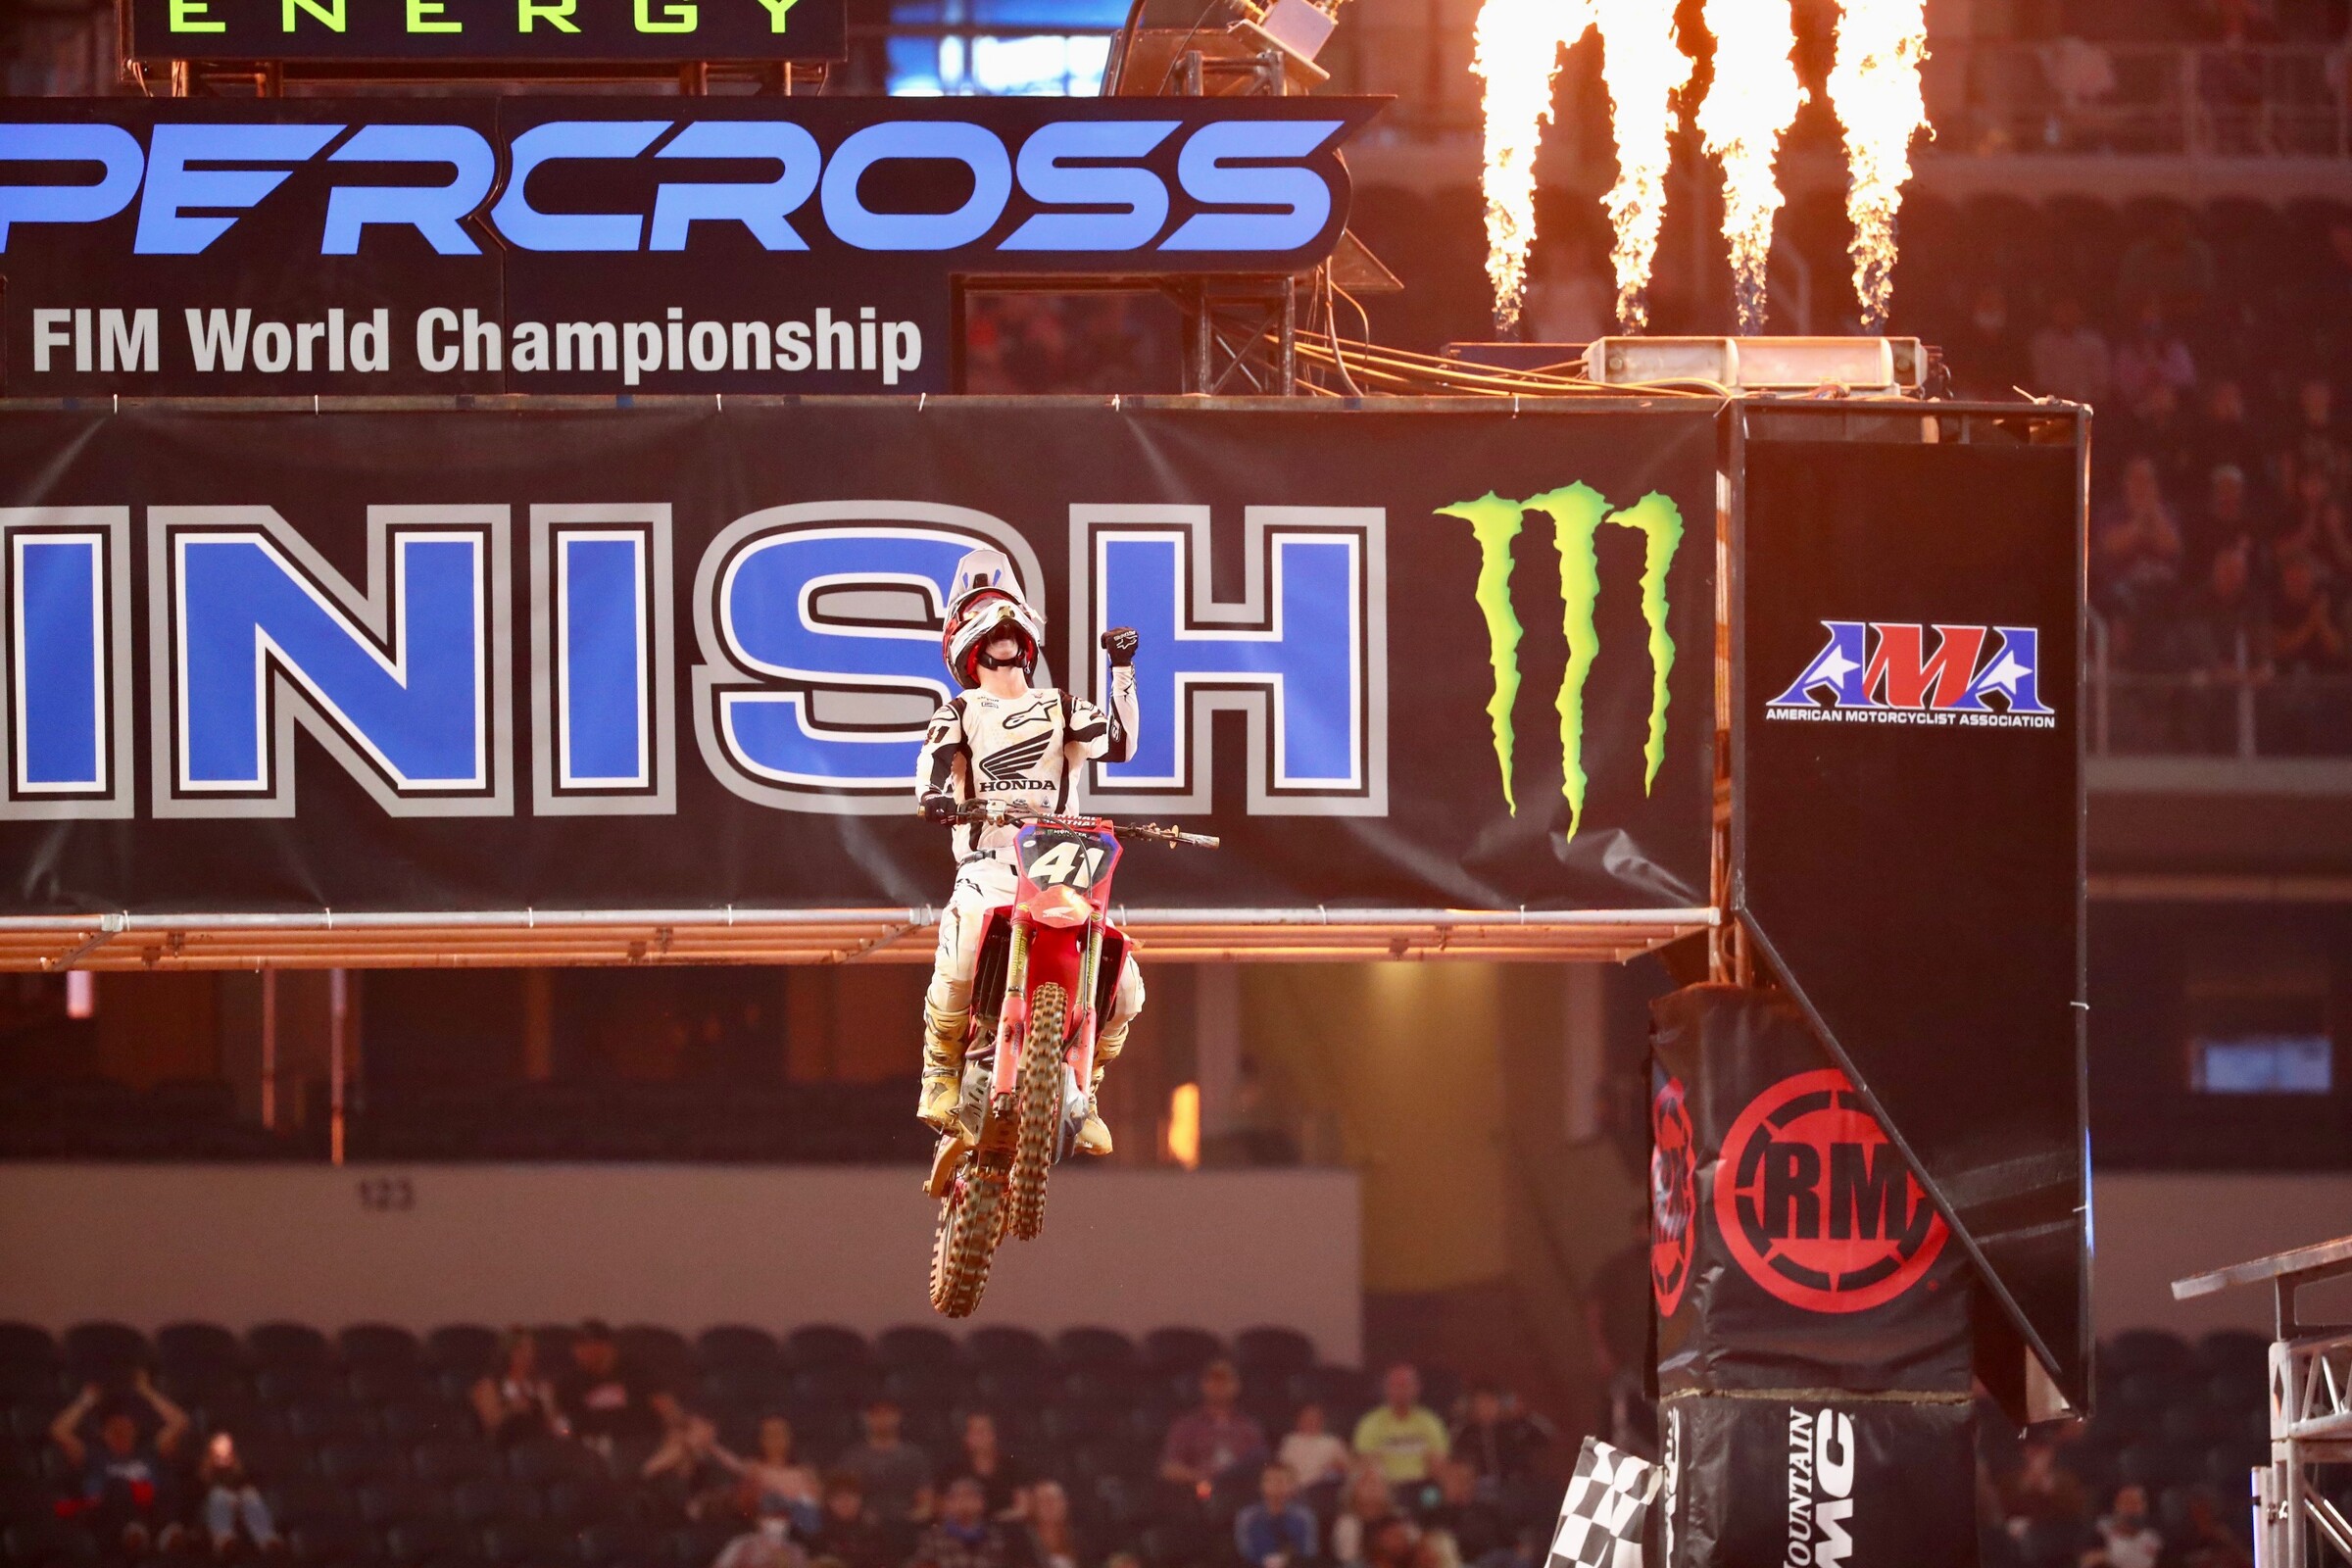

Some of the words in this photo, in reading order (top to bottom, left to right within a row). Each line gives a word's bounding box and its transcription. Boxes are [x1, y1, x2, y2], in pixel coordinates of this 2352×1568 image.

[171, 0, 799, 34] ENERGY
[33, 309, 160, 372] FIM
[185, 309, 391, 373] World
[417, 307, 923, 387] Championship
[1765, 619, 2056, 714] AMA
[1765, 708, 1842, 722] AMERICAN
[1844, 710, 1956, 726] MOTORCYCLIST
[1958, 712, 2056, 729] ASSOCIATION
[979, 780, 1057, 793] HONDA
[1027, 841, 1105, 890] 41
[1764, 1141, 1909, 1241] RM
[1784, 1405, 1813, 1568] OUNTAIN
